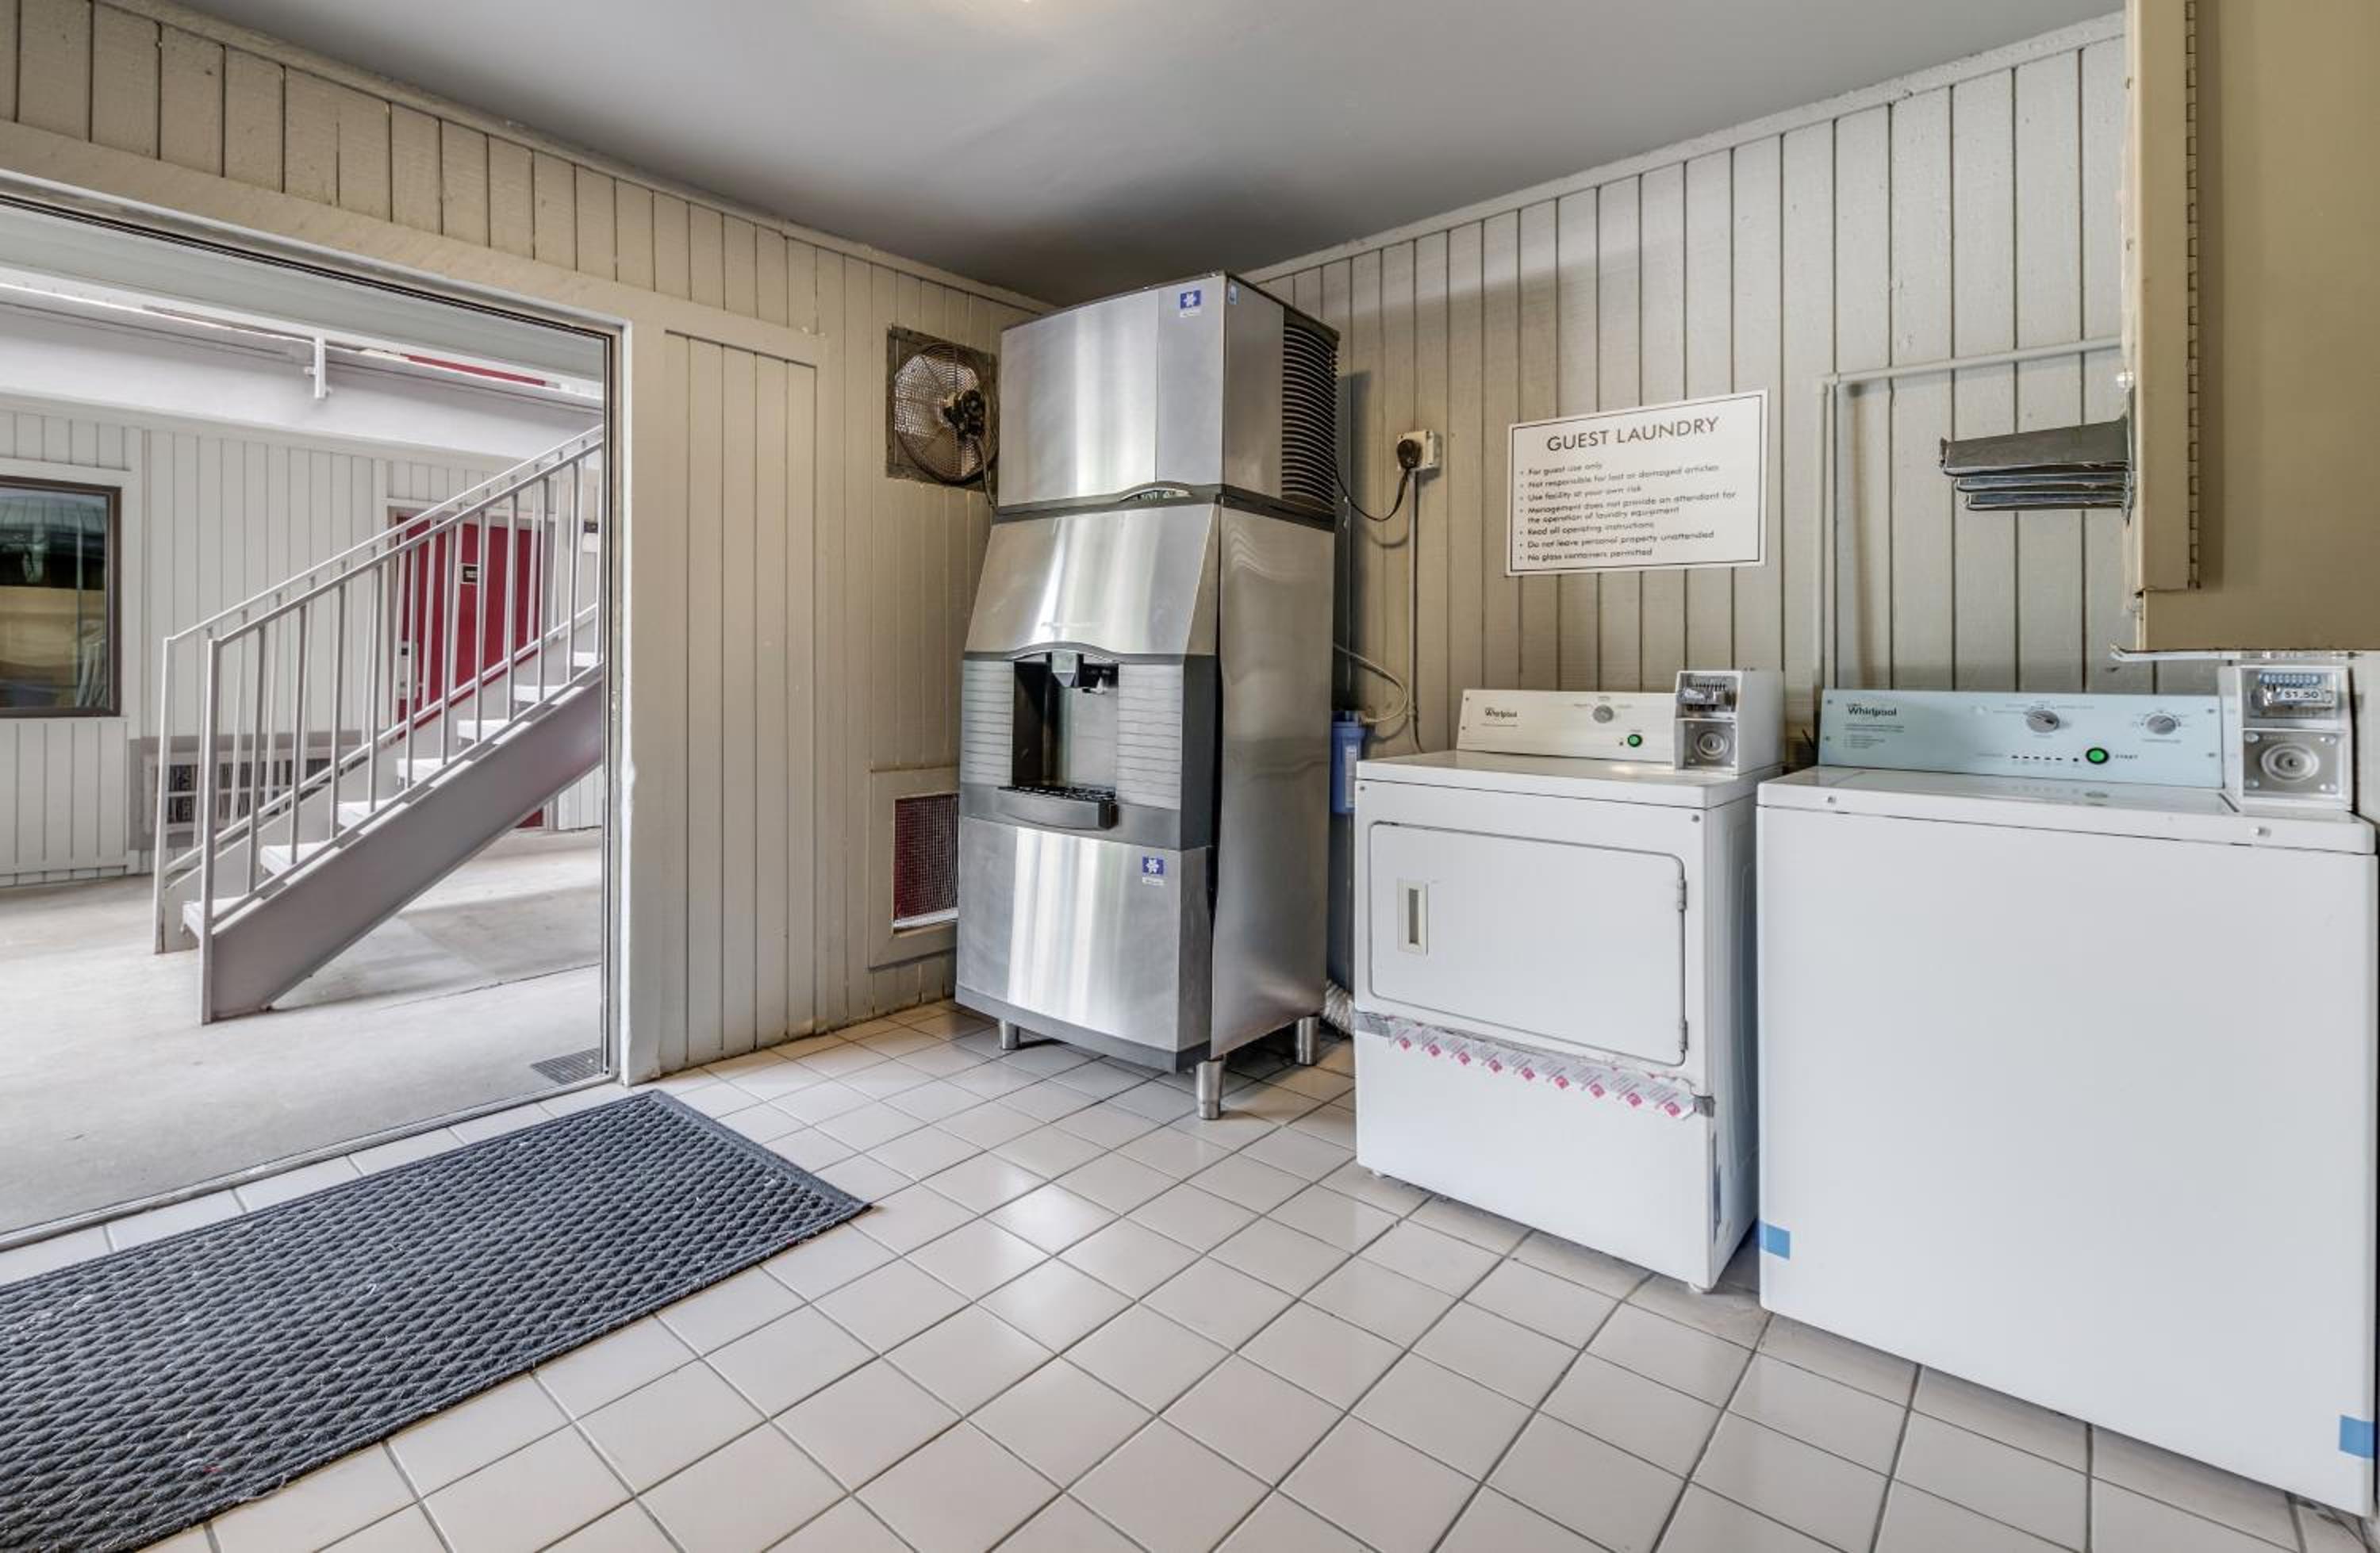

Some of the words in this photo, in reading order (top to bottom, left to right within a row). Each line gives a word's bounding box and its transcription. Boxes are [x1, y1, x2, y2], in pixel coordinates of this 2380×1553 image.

[1547, 430, 1609, 451] GUEST
[1617, 416, 1719, 443] LAUNDRY
[1543, 466, 1565, 476] guest
[1585, 462, 1602, 471] only
[1545, 477, 1591, 486] responsible
[1638, 466, 1682, 477] damaged
[1528, 504, 1581, 513] Management
[1622, 497, 1656, 508] provide
[1674, 491, 1719, 501] attendant
[1722, 490, 1736, 499] for
[1545, 492, 1571, 500] facility
[1543, 513, 1582, 523] operation
[1595, 511, 1627, 520] laundry
[1630, 507, 1679, 517] equipment
[1528, 527, 1548, 535] Read
[1562, 525, 1602, 535] operating
[1605, 522, 1654, 531] instructions
[1581, 536, 1618, 546] personal
[1621, 535, 1657, 543] property
[1660, 530, 1714, 540] unattended
[1542, 553, 1562, 562] glass
[1610, 548, 1653, 558] permitted
[1484, 709, 1518, 719] Whirlpool
[1848, 706, 1897, 717] Whirlpool
